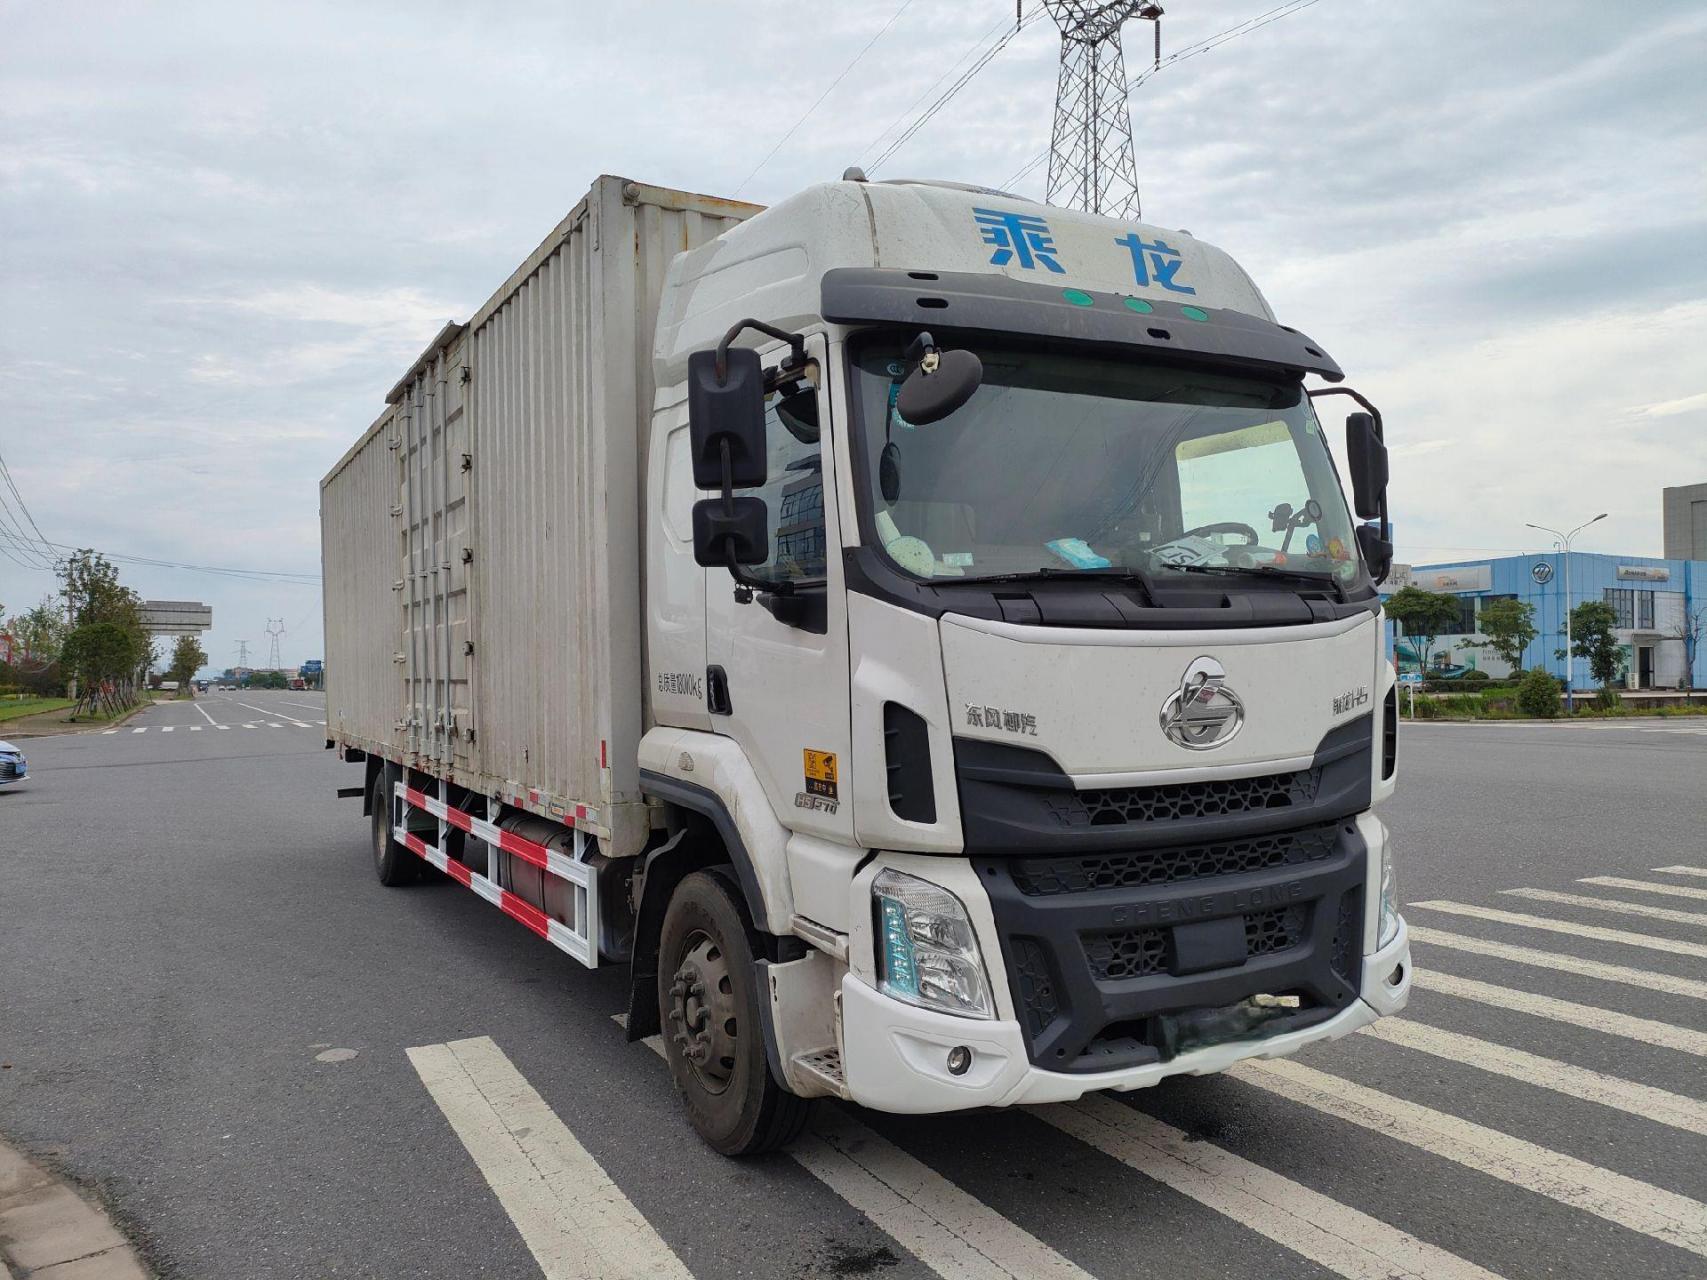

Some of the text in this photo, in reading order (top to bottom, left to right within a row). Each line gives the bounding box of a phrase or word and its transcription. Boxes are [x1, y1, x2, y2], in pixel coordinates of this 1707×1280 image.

[971, 207, 1197, 295] 乘龙
[965, 702, 1038, 736] 东风柳汽
[1111, 880, 1303, 923] CHENG LONG
